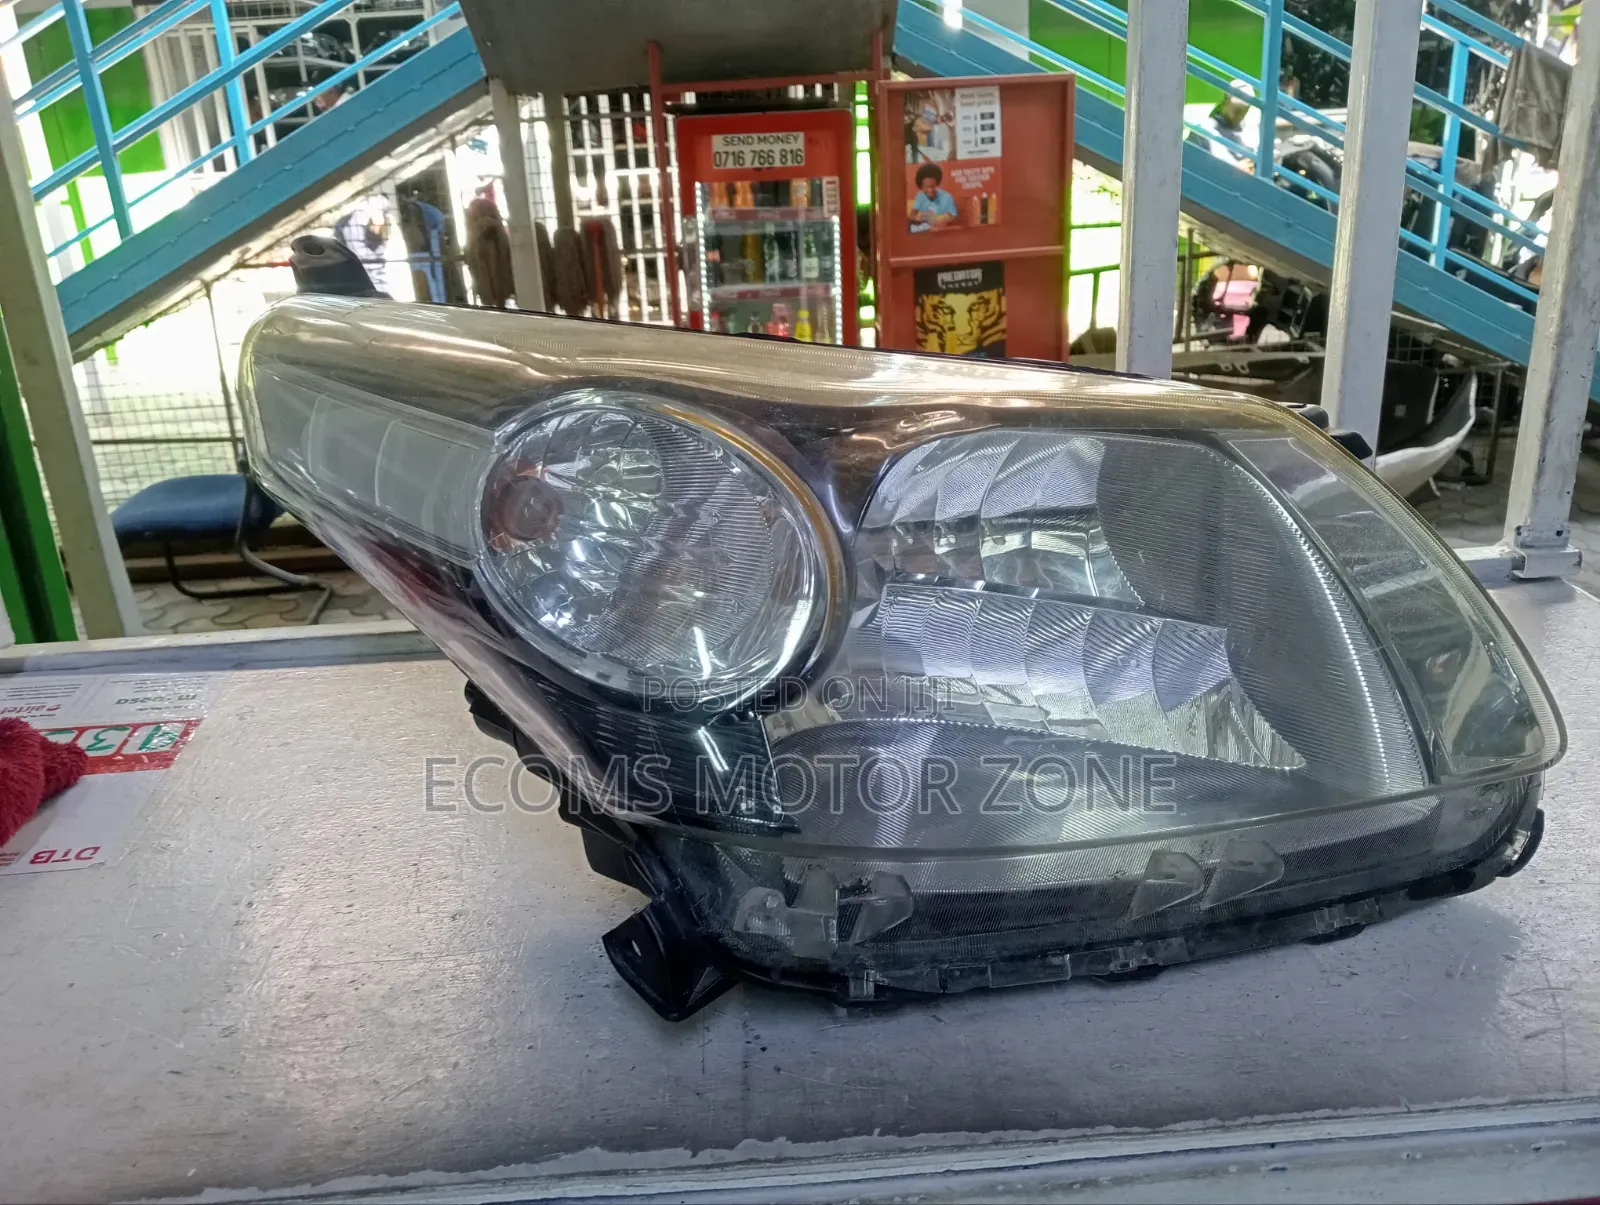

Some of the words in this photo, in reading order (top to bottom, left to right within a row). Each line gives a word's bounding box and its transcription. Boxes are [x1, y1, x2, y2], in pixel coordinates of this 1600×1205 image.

[723, 135, 755, 146] SEND
[757, 134, 799, 145] MONEY
[714, 150, 745, 168] 0716
[749, 149, 776, 166] 766
[780, 148, 804, 165] 816
[29, 846, 101, 864] DTB
